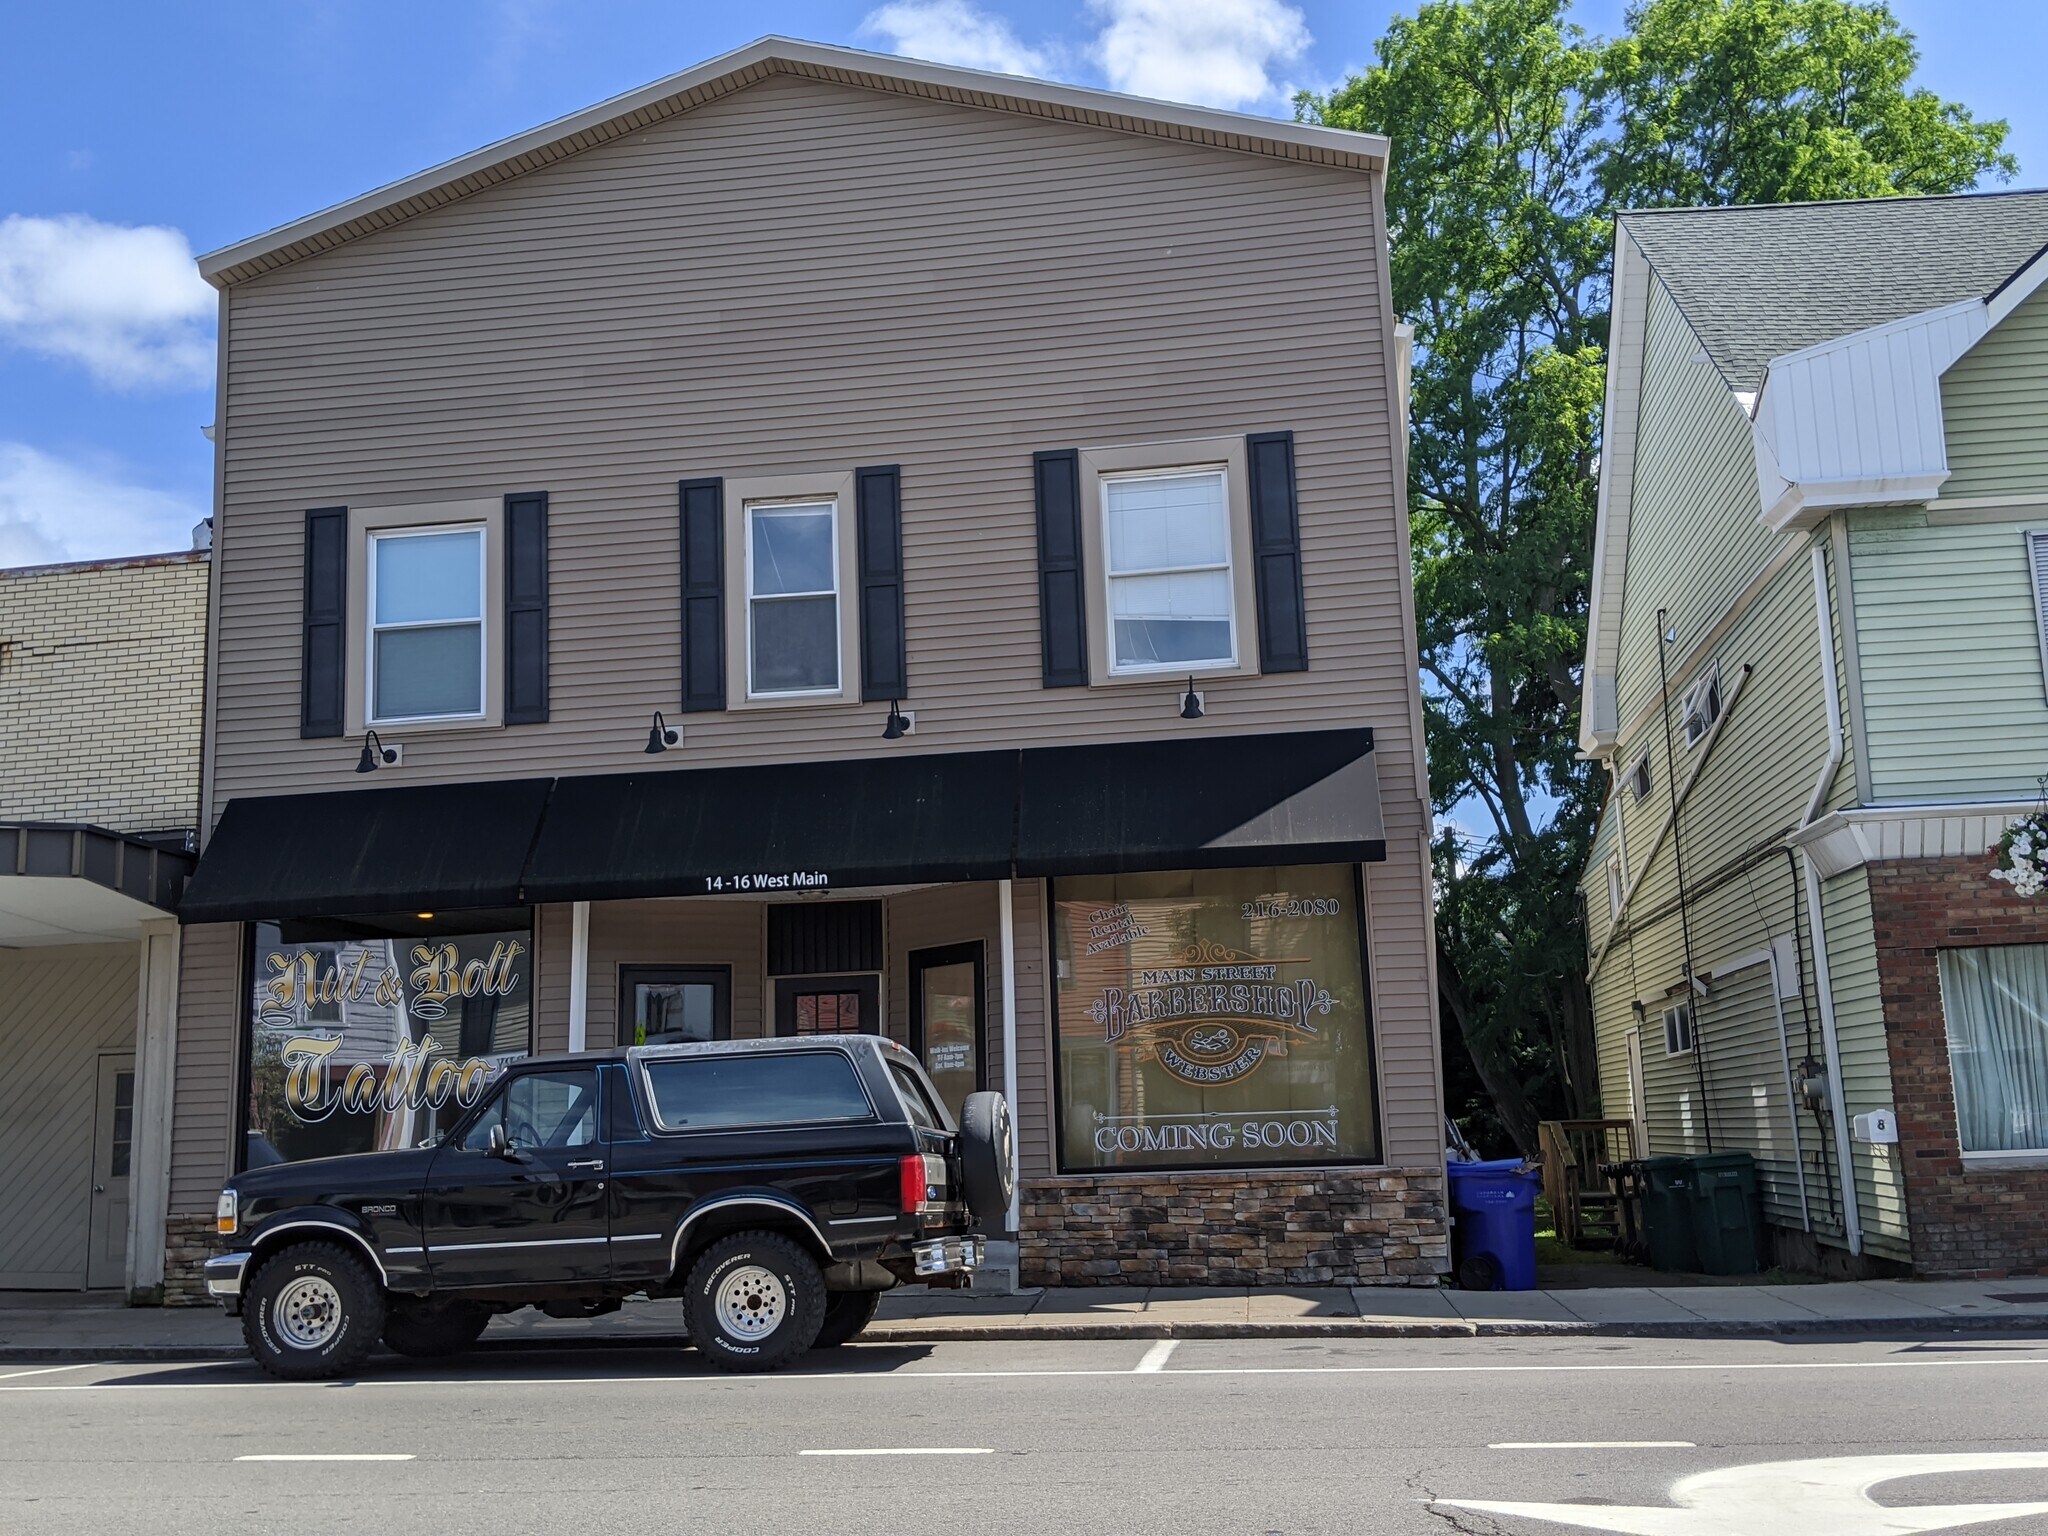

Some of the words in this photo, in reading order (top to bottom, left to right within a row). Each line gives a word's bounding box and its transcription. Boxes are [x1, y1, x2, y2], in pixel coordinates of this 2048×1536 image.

[753, 874, 789, 888] West
[793, 871, 828, 886] Main
[1088, 904, 1128, 924] Chair
[1241, 898, 1340, 919] 216-2080
[1088, 913, 1136, 939] Rental
[1086, 925, 1151, 956] Available
[258, 948, 375, 1028] Nut
[374, 966, 403, 1008] &
[410, 940, 525, 1019] Bolt
[1141, 969, 1195, 986] MAIN
[1201, 965, 1276, 981] STREET
[1100, 979, 1318, 1042] BARBERSHOP
[1163, 1048, 1260, 1080] WEBSTER
[281, 1033, 496, 1123] Tattoo
[1095, 1122, 1235, 1152] COMING
[1242, 1119, 1338, 1148] SOON
[1877, 1119, 1885, 1130] 8
[361, 1204, 397, 1214] BRONCO
[294, 1263, 316, 1272] STT
[316, 1266, 332, 1276] PRO
[703, 1253, 751, 1295] DISCOVERER
[783, 1274, 797, 1296] STT
[259, 1297, 282, 1355] DISCOVERER
[321, 1315, 350, 1356] COOPER
[714, 1335, 760, 1354] COOPER
